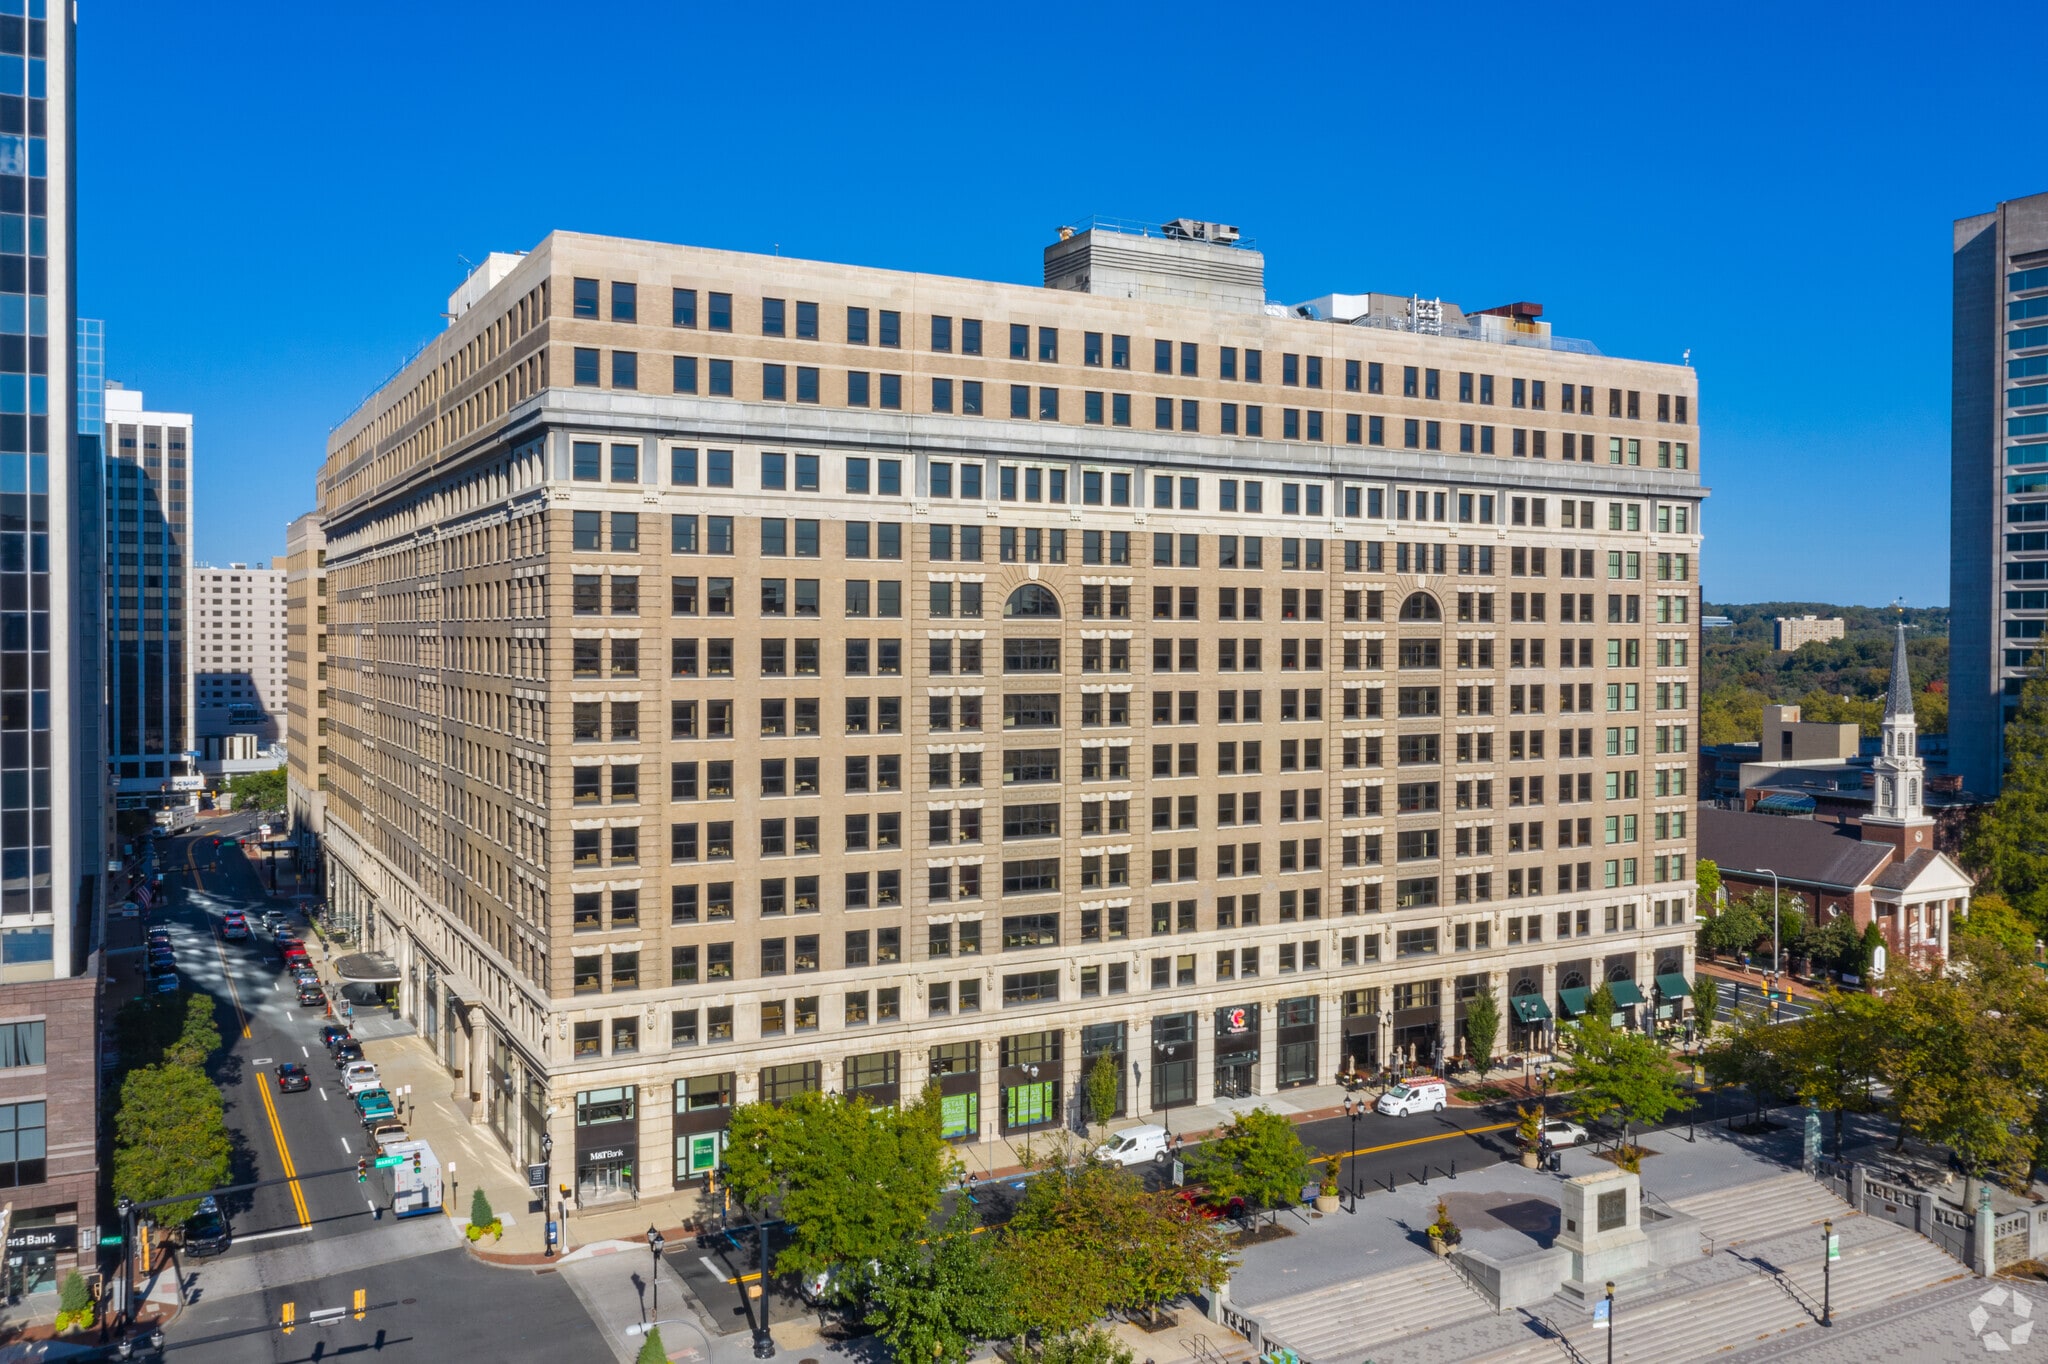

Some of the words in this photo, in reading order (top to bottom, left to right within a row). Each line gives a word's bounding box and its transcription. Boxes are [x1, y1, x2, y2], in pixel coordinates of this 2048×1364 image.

[590, 1151, 607, 1161] M&T
[607, 1149, 624, 1159] Bank
[376, 1157, 397, 1166] MARKET
[26, 1232, 56, 1245] Bank
